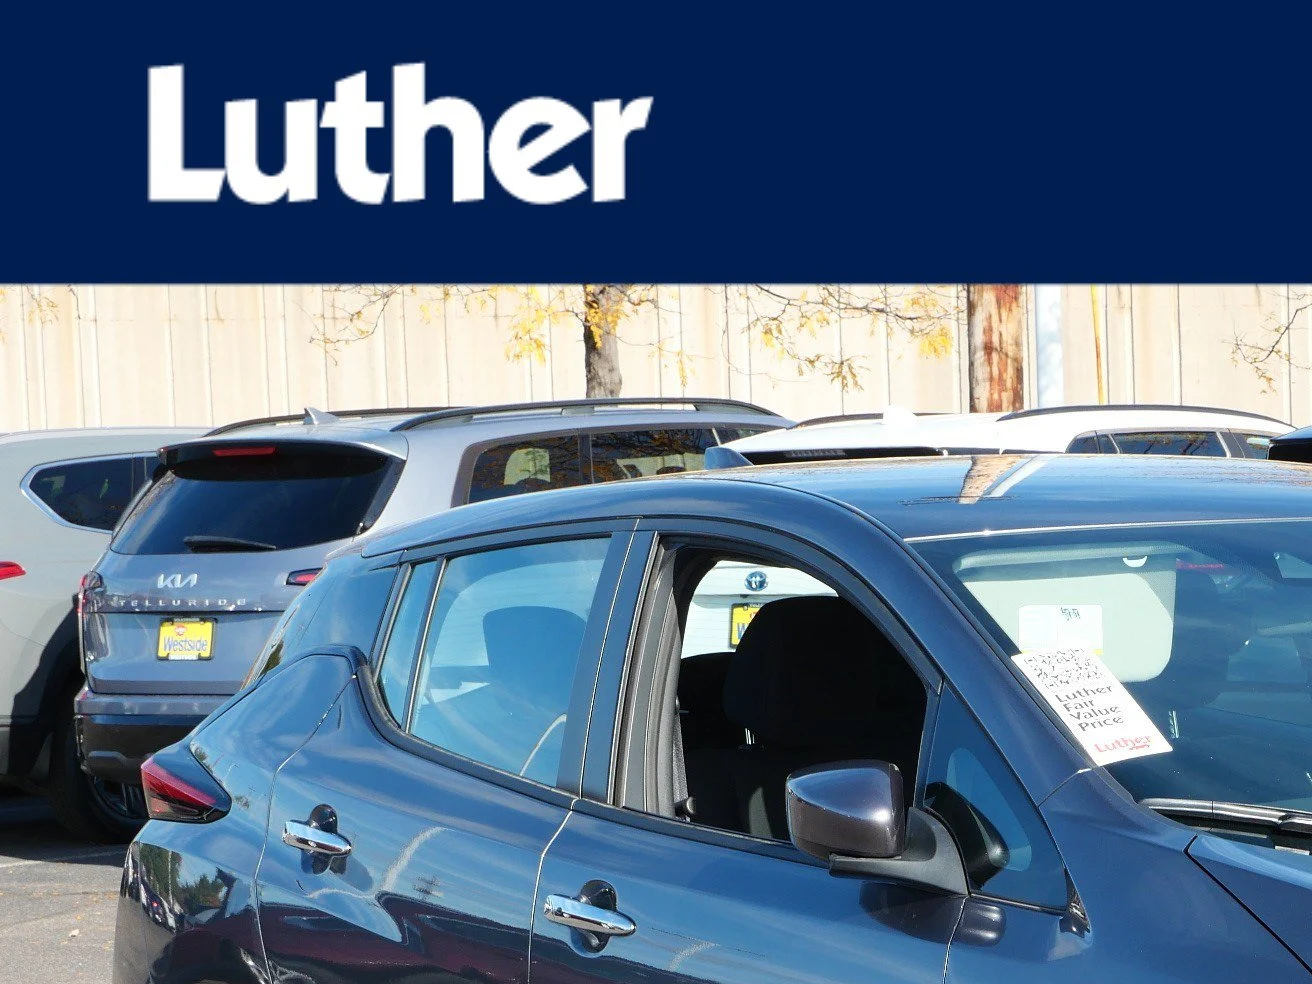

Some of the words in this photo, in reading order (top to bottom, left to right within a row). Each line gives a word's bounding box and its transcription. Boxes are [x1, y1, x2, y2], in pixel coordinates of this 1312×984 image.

[119, 598, 246, 607] TELLURIDE
[163, 636, 208, 652] Westside
[1055, 684, 1114, 703] Luther
[1062, 699, 1095, 713] Fair
[1069, 704, 1124, 721] Value
[1077, 715, 1125, 732] Price
[1094, 735, 1152, 753] Luther
